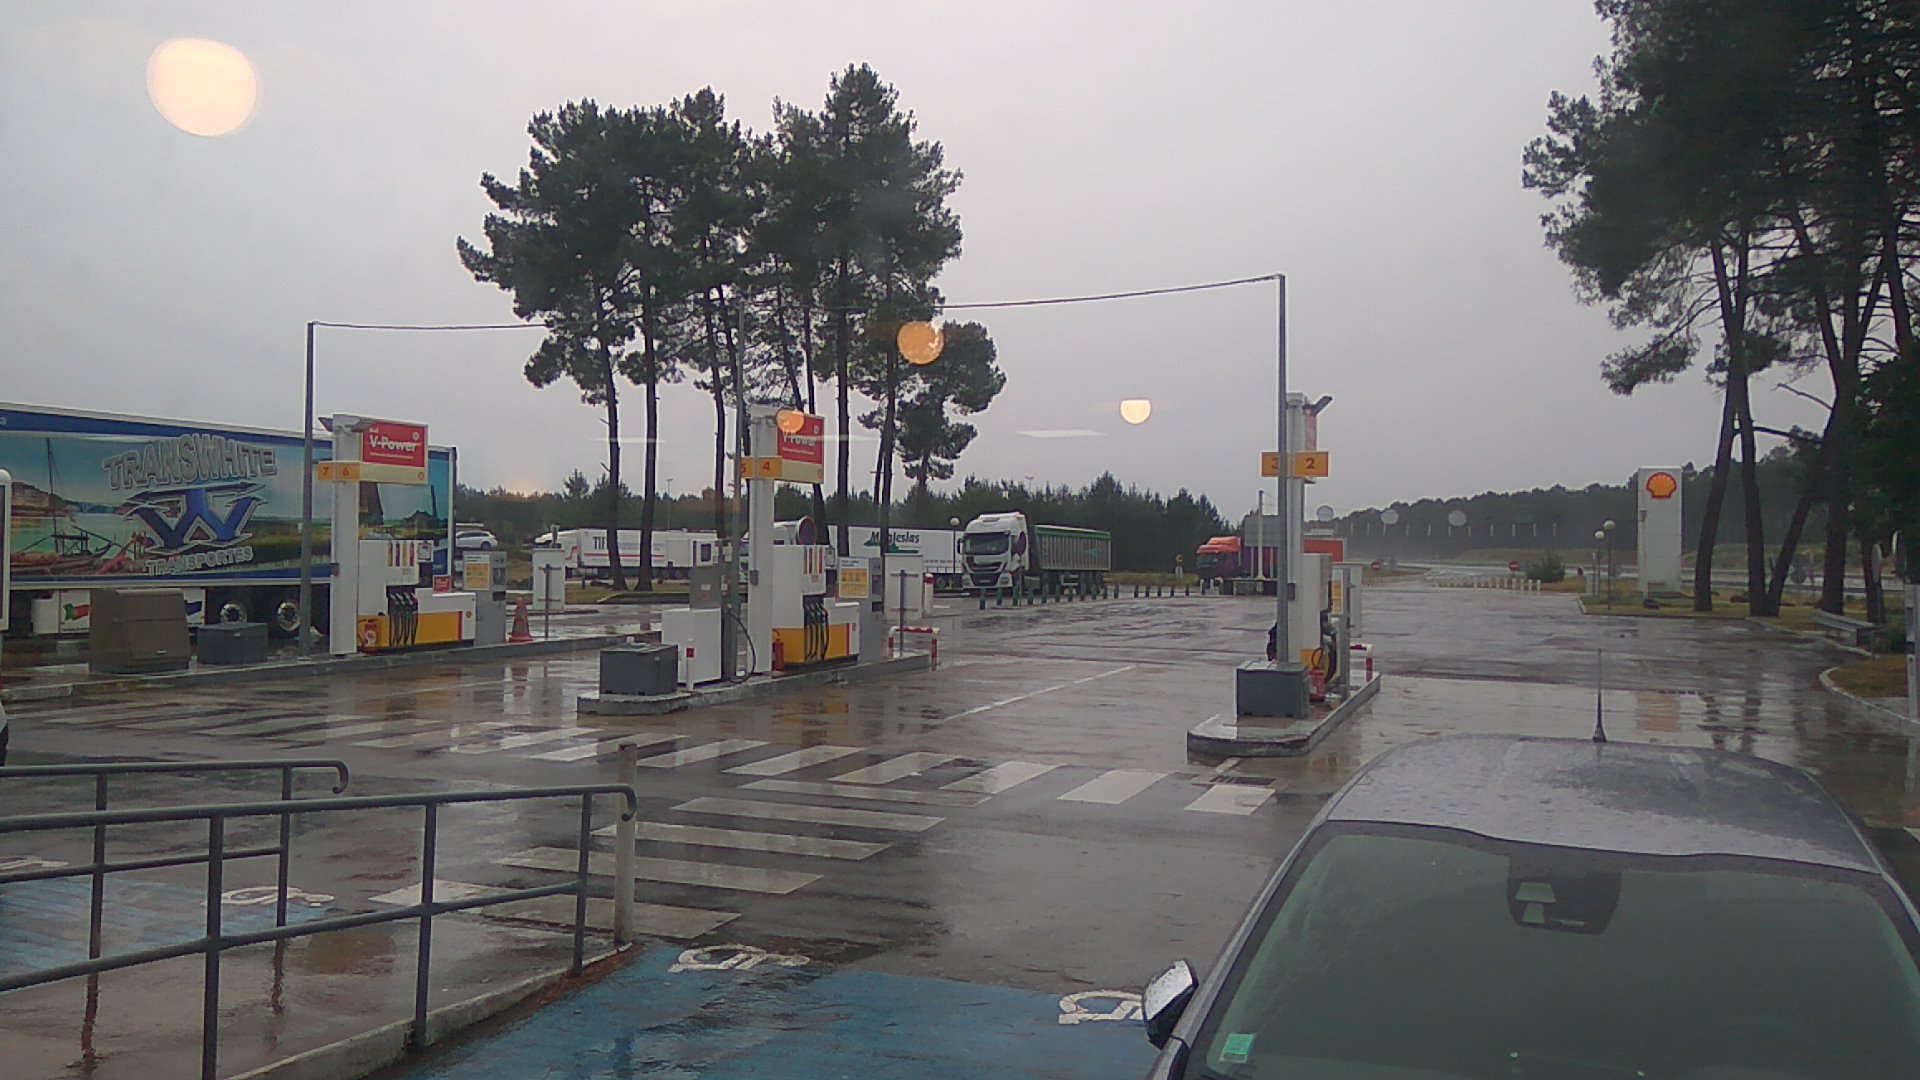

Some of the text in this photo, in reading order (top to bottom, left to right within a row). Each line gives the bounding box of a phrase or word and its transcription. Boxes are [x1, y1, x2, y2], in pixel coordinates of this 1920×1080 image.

[369, 434, 417, 452] V-Power
[103, 433, 277, 490] TRANSWHITE
[763, 461, 770, 471] 4
[1305, 457, 1316, 470] 2
[322, 466, 329, 476] 7
[343, 466, 350, 477] 6
[146, 546, 254, 575] TRANSPORTES
